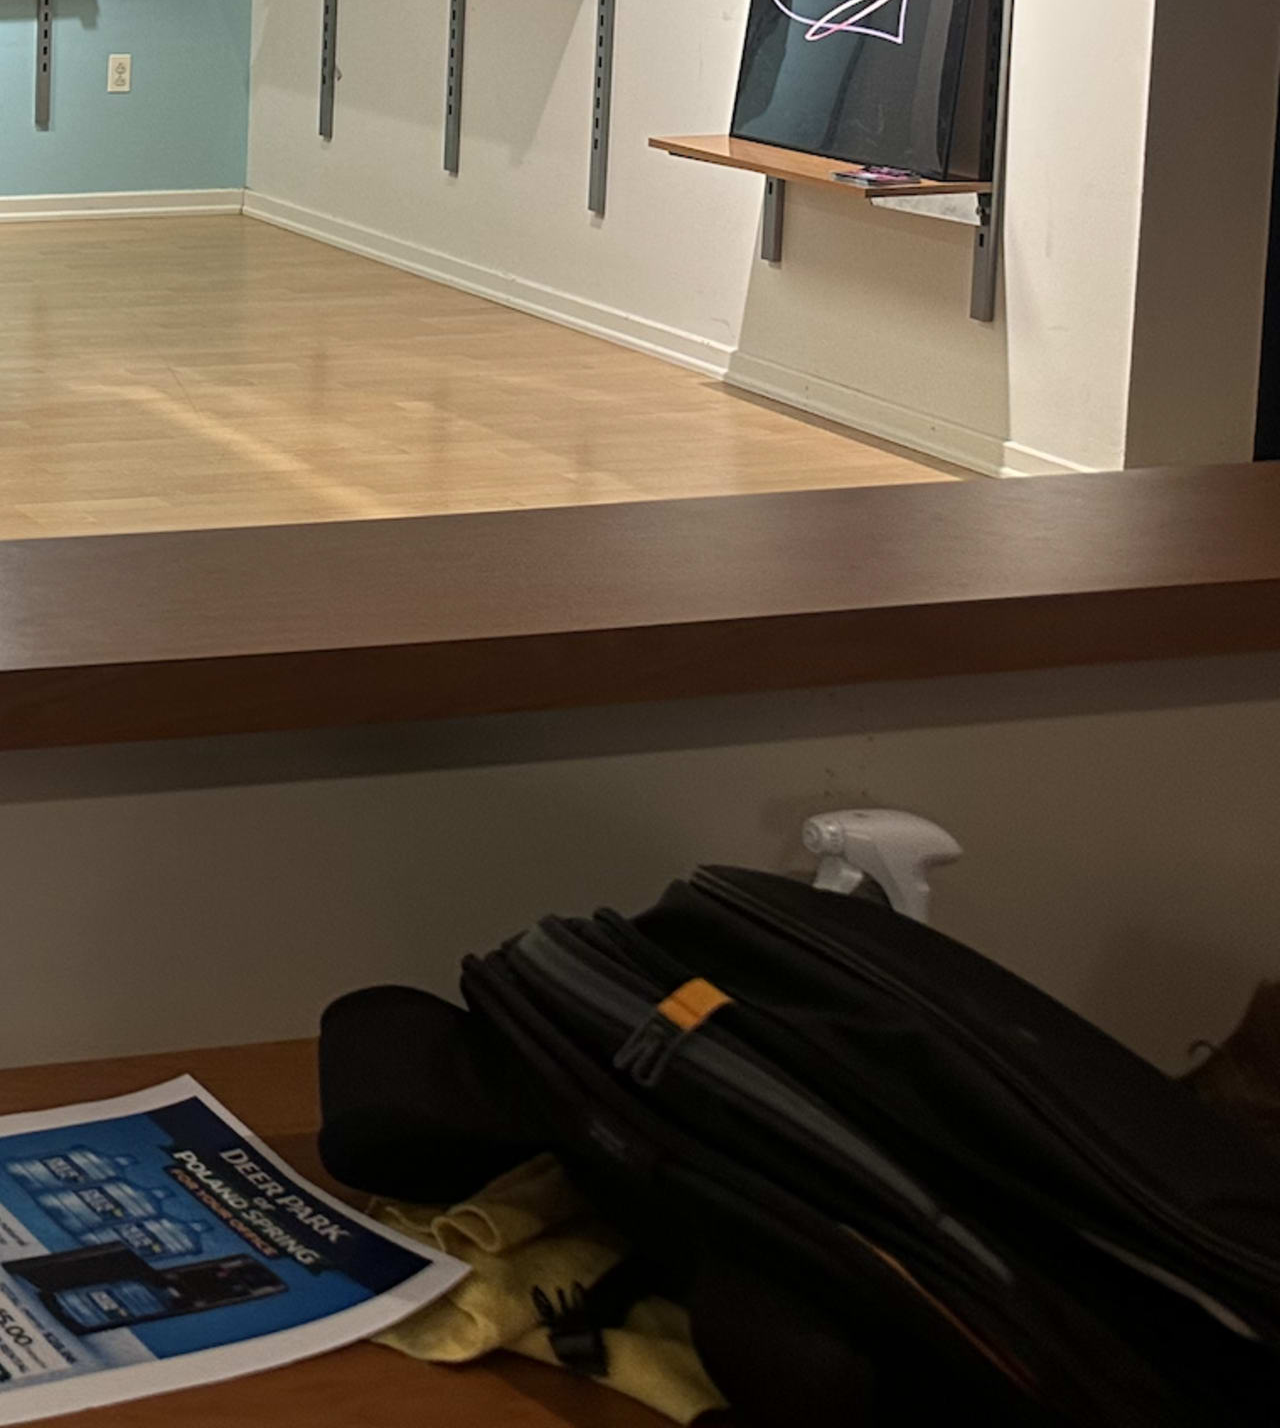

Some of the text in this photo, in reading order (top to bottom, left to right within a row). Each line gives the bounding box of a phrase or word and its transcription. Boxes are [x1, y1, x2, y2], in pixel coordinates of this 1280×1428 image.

[172, 1149, 321, 1265] POLAND SPRING
[220, 1148, 351, 1244] DEER PARK
